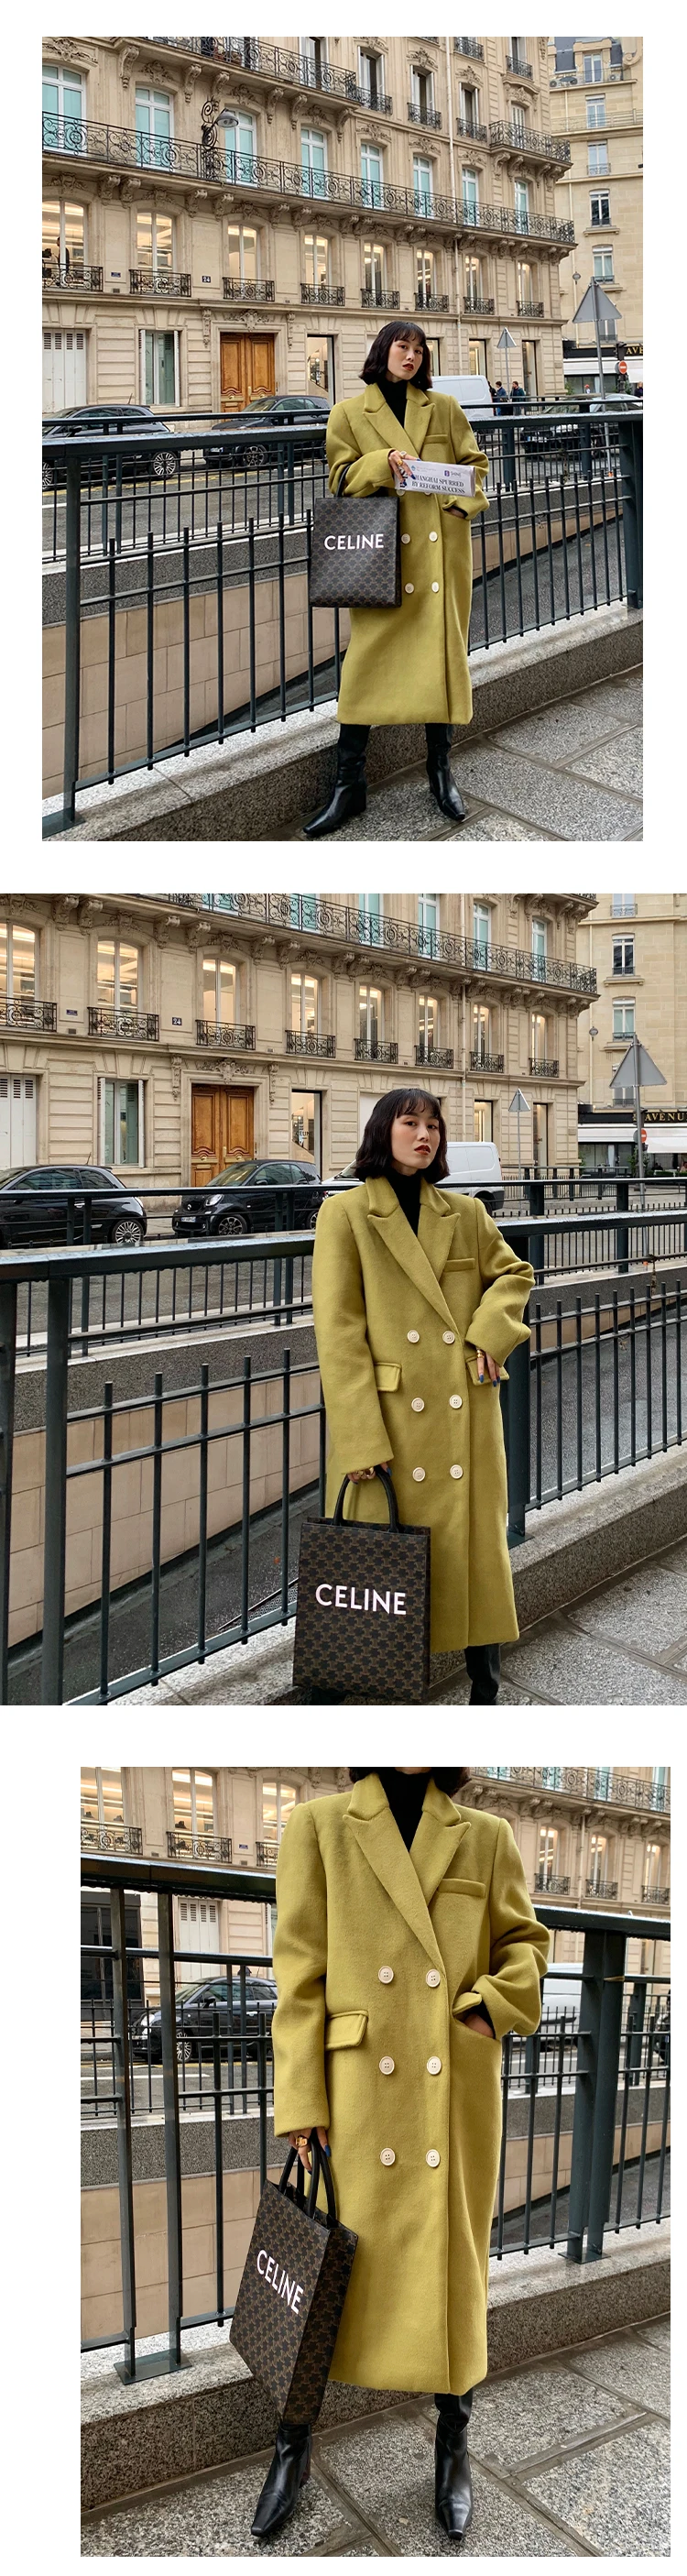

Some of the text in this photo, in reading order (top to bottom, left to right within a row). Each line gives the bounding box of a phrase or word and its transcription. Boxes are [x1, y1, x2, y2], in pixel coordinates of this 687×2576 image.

[415, 475, 464, 488] HANGHAI SPURRED
[419, 482, 441, 491] REFORM
[442, 485, 465, 494] SUCCESS
[324, 533, 384, 550] CELINE
[315, 1584, 407, 1615] CELINE
[257, 2250, 304, 2315] CELINE
